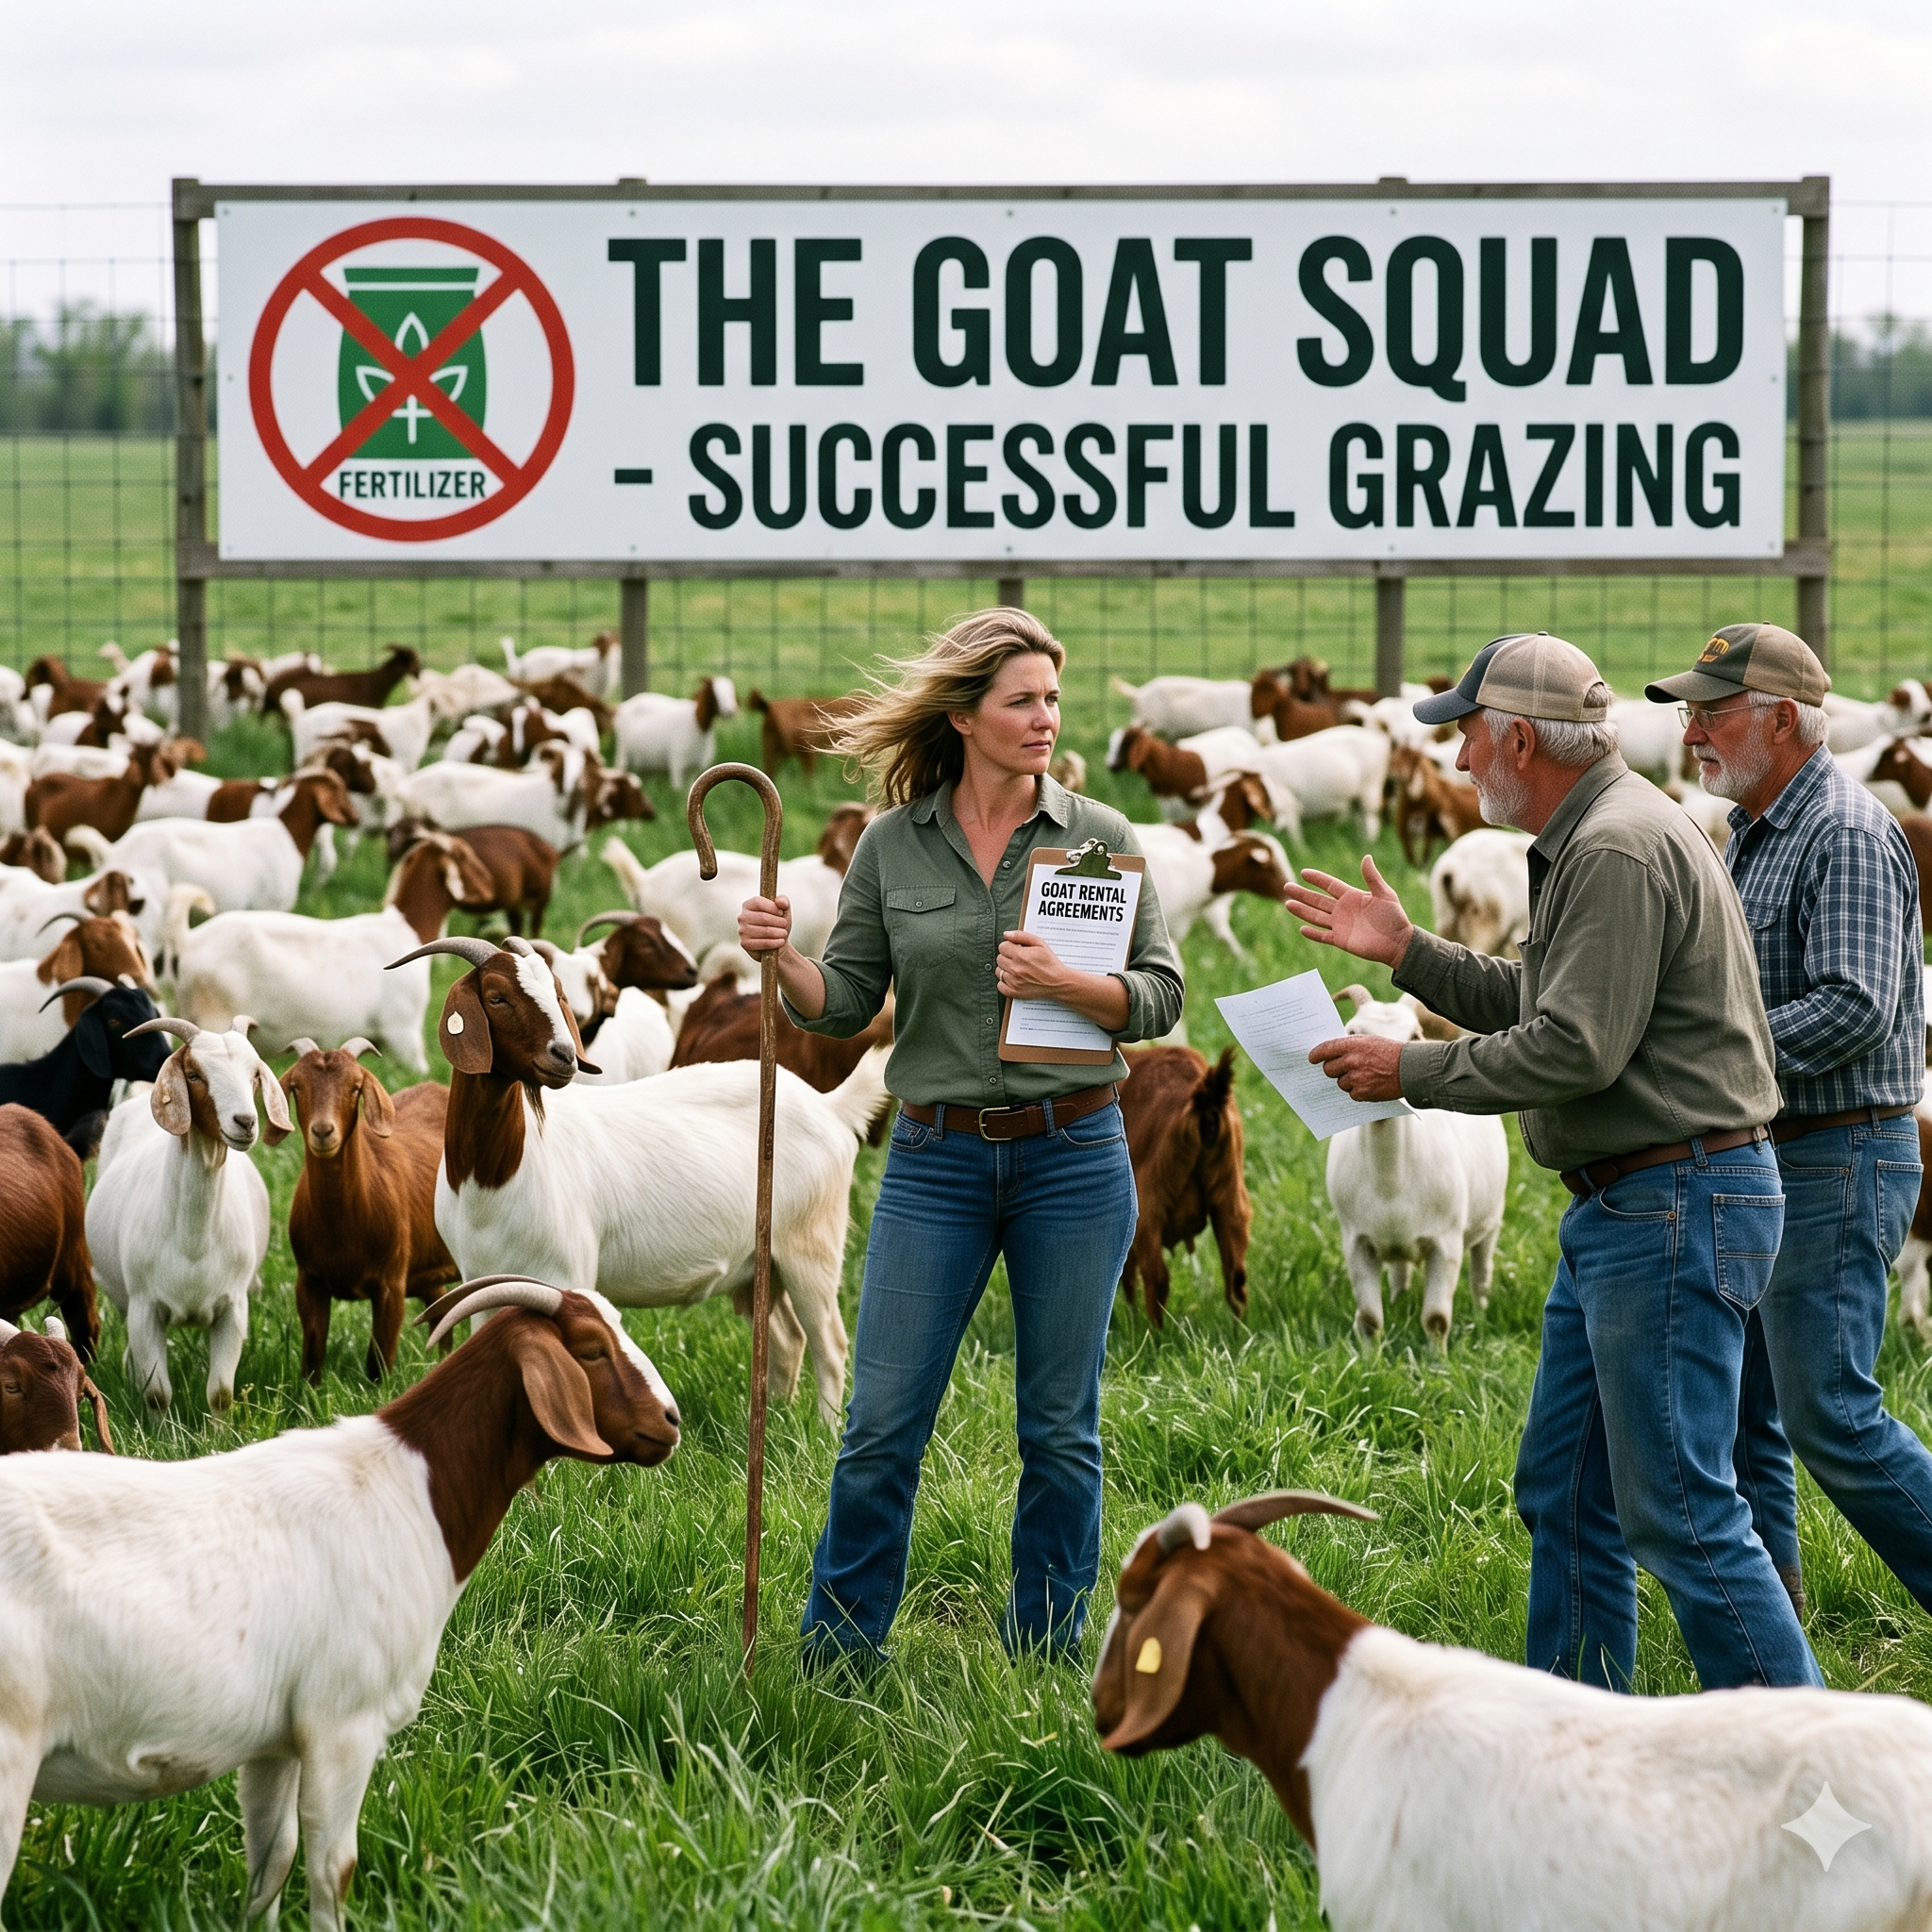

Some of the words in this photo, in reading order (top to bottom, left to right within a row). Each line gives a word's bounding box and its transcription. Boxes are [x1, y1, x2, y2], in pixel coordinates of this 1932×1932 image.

[608, 239, 865, 387] THE
[913, 238, 1253, 388] GOAT
[1297, 236, 1745, 403] SQUAD
[339, 471, 487, 499] FERTILIZER
[690, 424, 1295, 530] SUCCESSFUL
[1329, 423, 1741, 530] GRAZING
[1041, 881, 1076, 899] GOAT
[1078, 885, 1127, 905] RENTAL
[1038, 900, 1124, 923] AGREEMENTS
